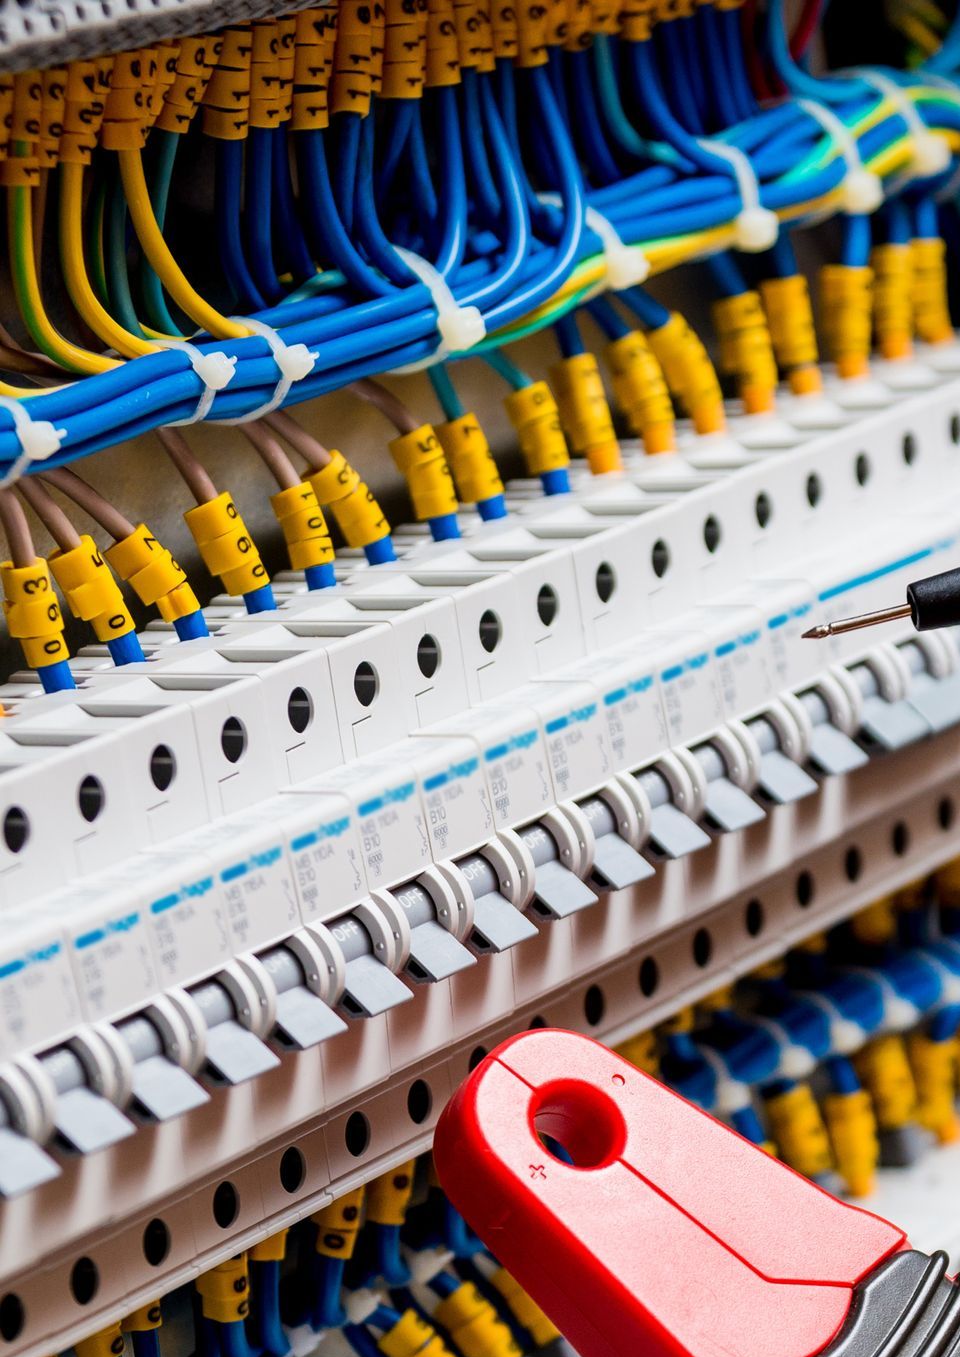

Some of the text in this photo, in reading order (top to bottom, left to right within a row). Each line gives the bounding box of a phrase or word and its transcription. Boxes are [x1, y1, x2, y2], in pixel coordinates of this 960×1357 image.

[460, 859, 487, 882] OFF
[397, 888, 424, 910] OFF
[331, 919, 359, 944] OFF
